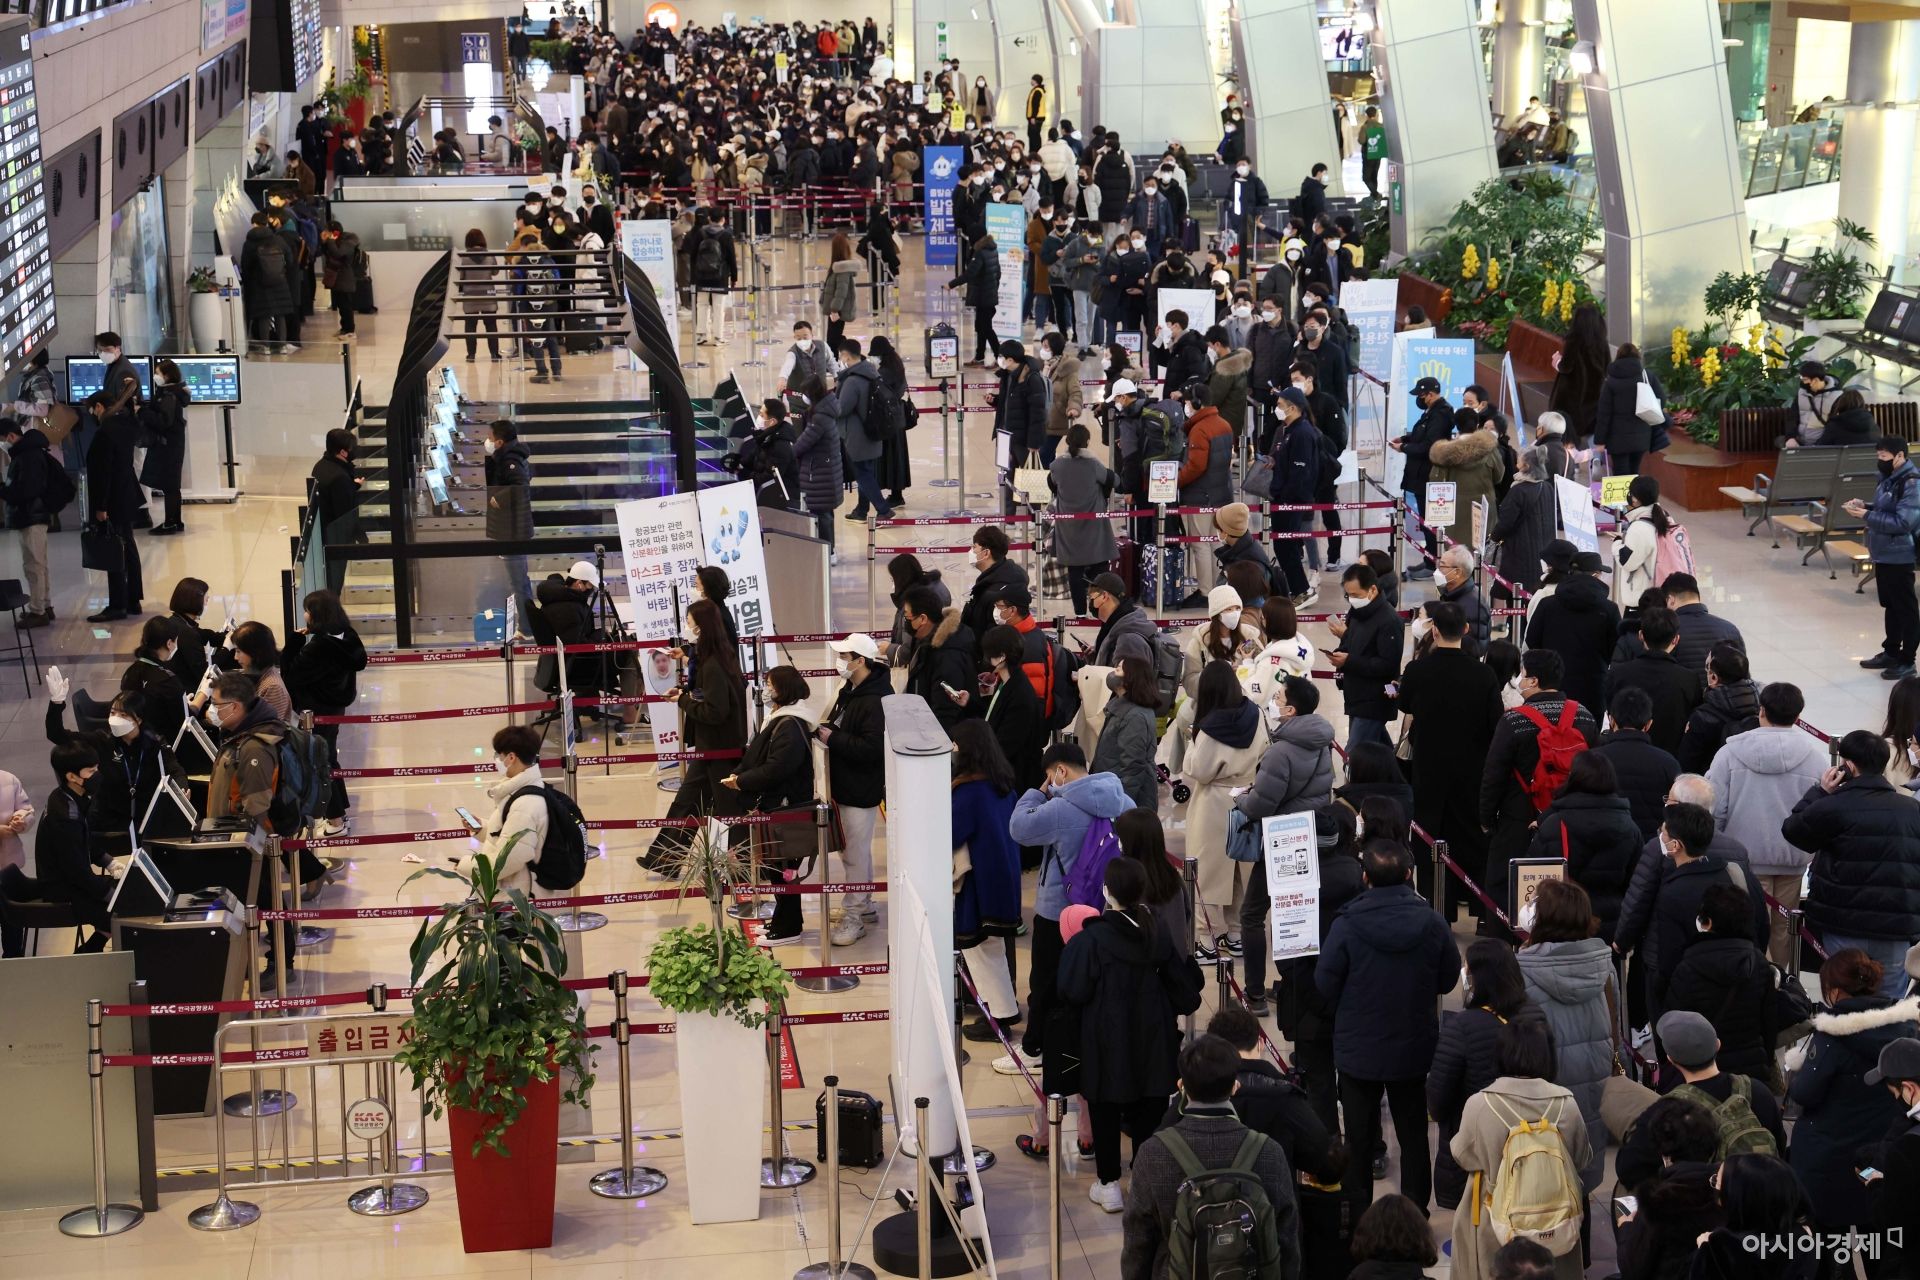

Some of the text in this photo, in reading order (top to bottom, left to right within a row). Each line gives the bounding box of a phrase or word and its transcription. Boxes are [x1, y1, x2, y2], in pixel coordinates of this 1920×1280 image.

[632, 238, 662, 246] 손하나로
[632, 246, 663, 256] 탑승하자
[1414, 346, 1468, 356] 이제 신분증 대신
[635, 521, 683, 536] 항공보안 관련
[628, 530, 694, 548] 규정에 따라 탑승객
[631, 542, 694, 559] 신분확인을 위하여
[631, 556, 700, 580] 마스크를 잠깐
[647, 630, 665, 638] 마스크
[437, 830, 467, 838] 한국공항공사
[1290, 834, 1308, 844] 신분증
[1274, 855, 1293, 864] 탑승권
[846, 884, 876, 892] 한국공항공사
[604, 893, 658, 903] KAC 한국공항공사
[1275, 900, 1291, 909] 신분증
[1292, 899, 1303, 907] 확인
[382, 908, 413, 916] 한국공항공사
[840, 964, 888, 974] KAC 한국공항
[254, 998, 316, 1009] KAC 한국공항공사
[151, 1004, 214, 1014] KAC 한국공항공사
[842, 1011, 889, 1021] KAC 한국공항
[318, 1026, 416, 1052] 출입금지
[152, 1055, 215, 1064] KAC 한국공항공사
[256, 1050, 308, 1060] KAC 한국공항
[354, 1113, 384, 1122] KAC
